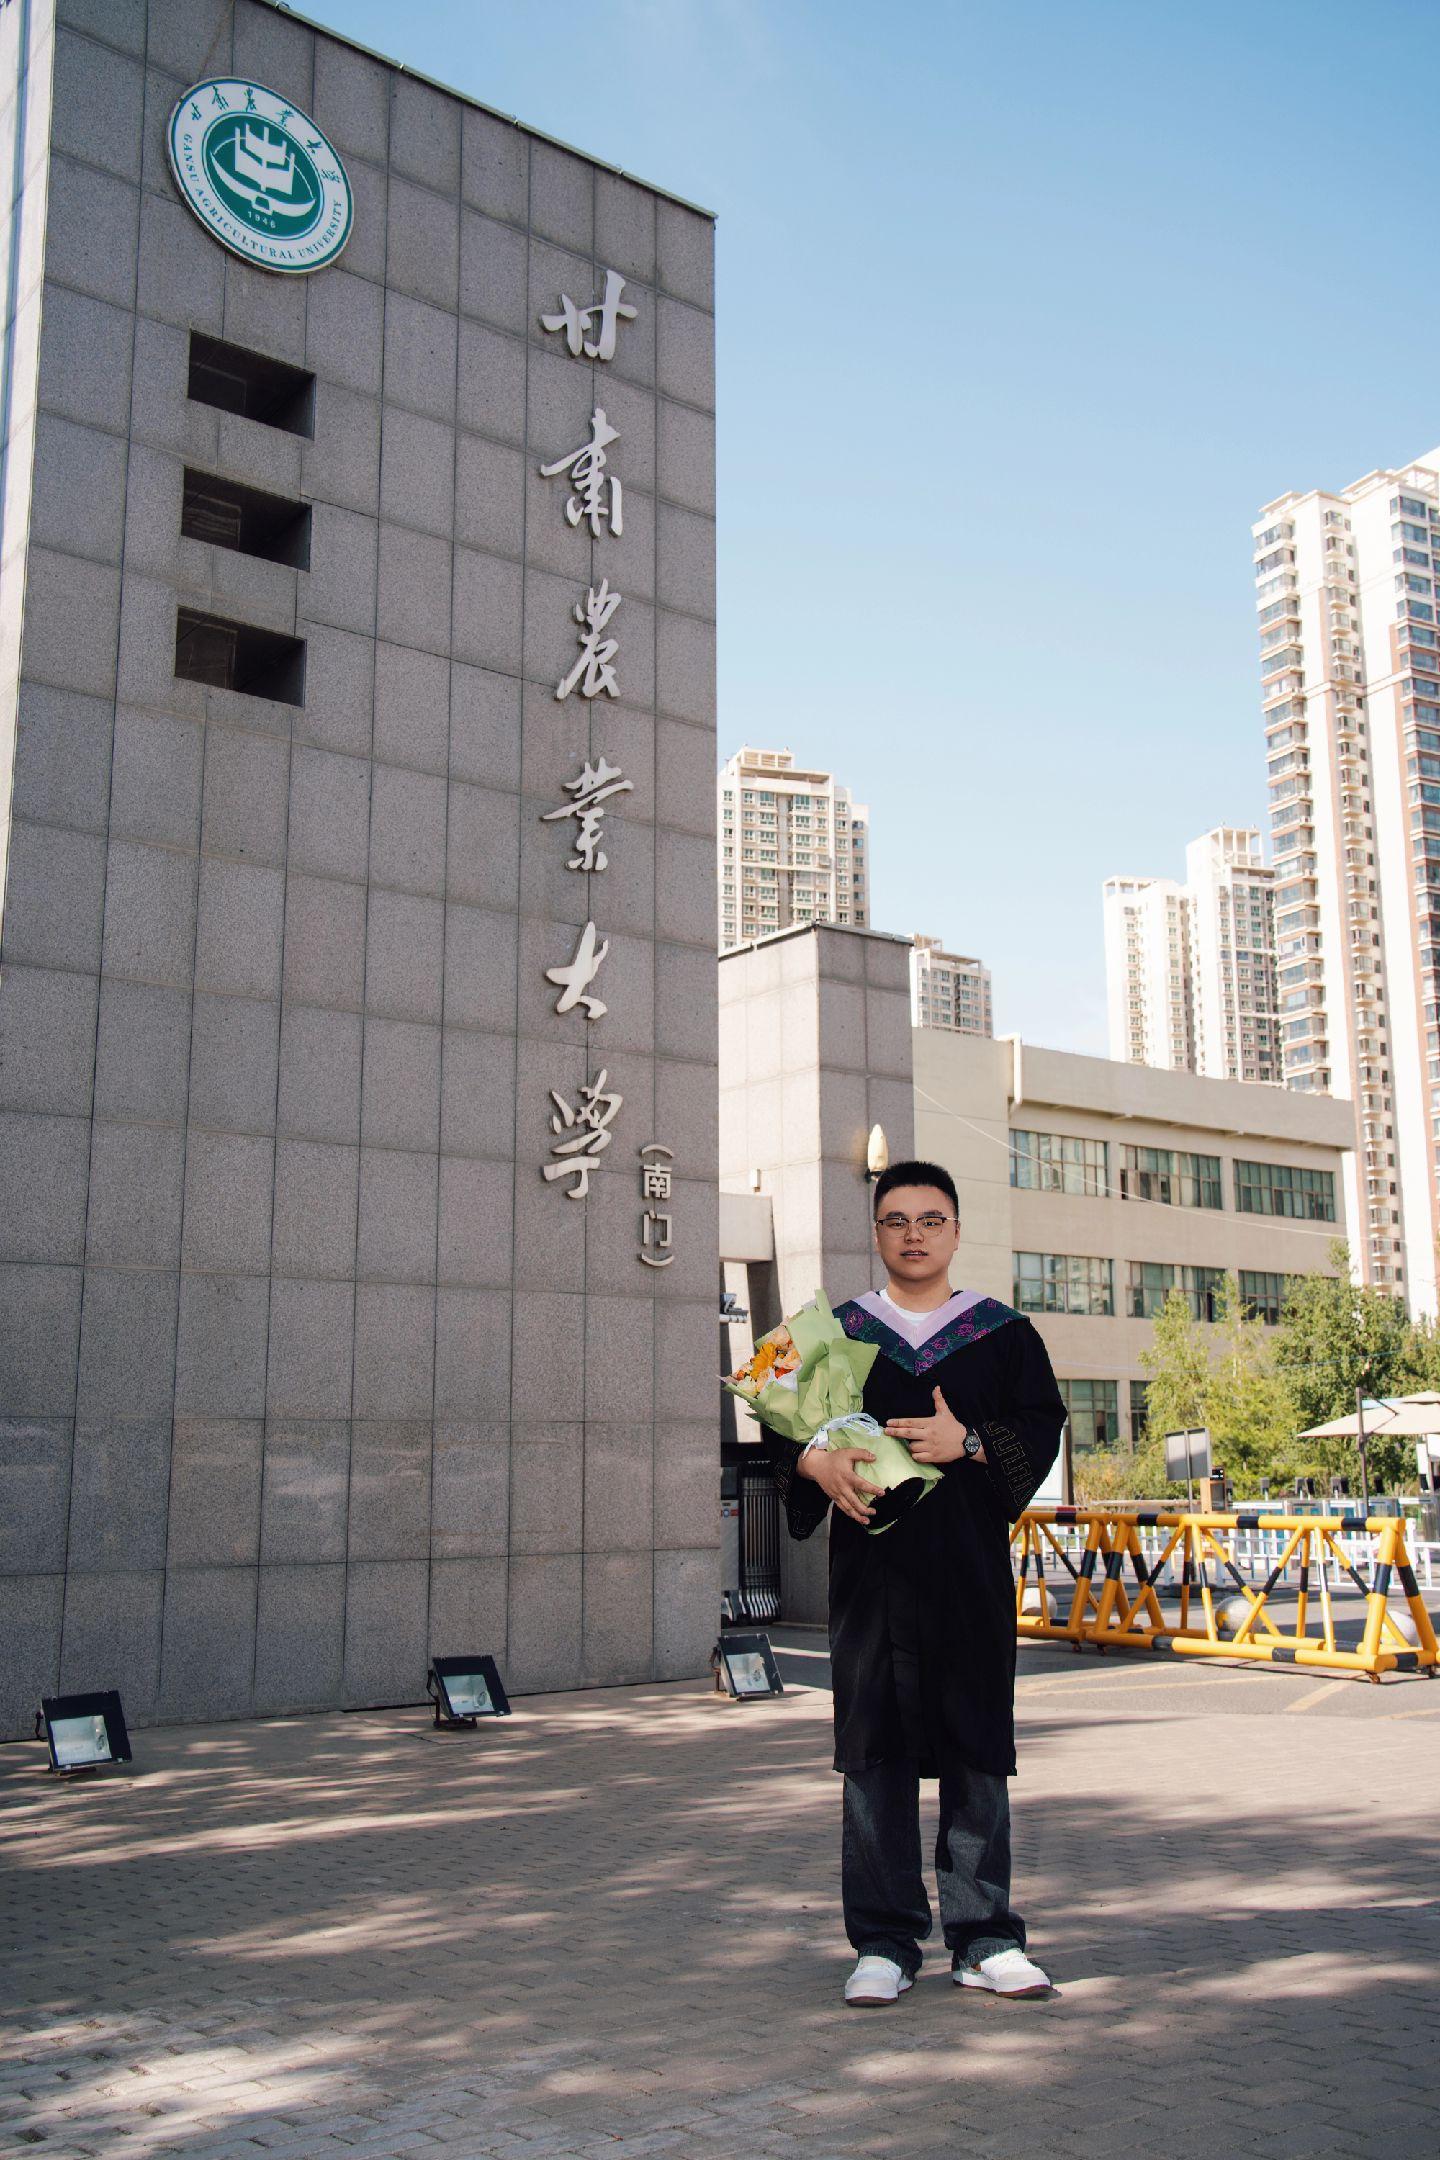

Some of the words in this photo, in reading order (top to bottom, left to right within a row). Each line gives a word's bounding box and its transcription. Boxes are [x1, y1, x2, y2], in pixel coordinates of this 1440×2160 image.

[183, 134, 200, 182] GANSU
[196, 188, 295, 259] AGRICULTURAL
[298, 200, 342, 258] UNIVERSITY
[248, 211, 276, 228] 1946
